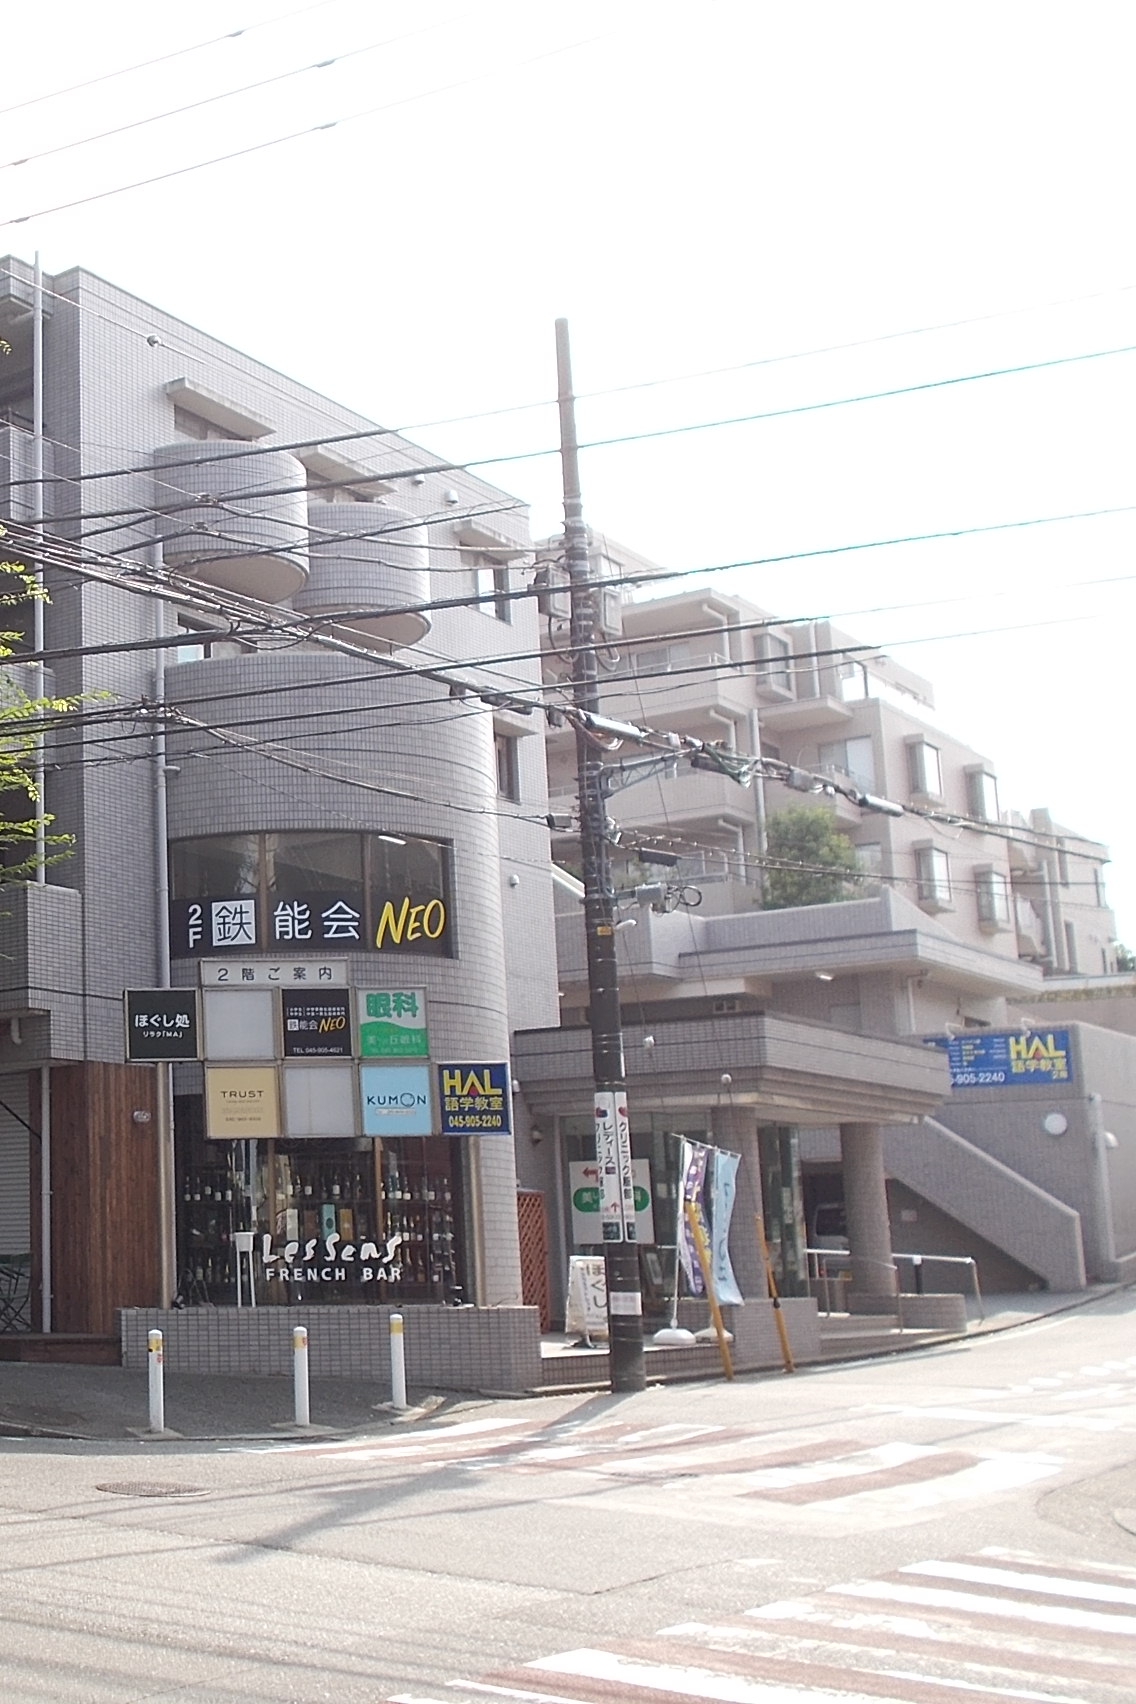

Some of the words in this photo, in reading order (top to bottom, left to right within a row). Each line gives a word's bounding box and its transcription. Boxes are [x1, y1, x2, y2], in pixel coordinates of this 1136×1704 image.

[376, 896, 446, 948] NEO
[217, 967, 333, 982] 2階ご案内
[366, 992, 419, 1018] 眼科
[135, 1014, 190, 1028] ほぐし処
[318, 1017, 346, 1033] NEO
[1009, 1034, 1066, 1059] HAL
[443, 1069, 503, 1096] HAL
[221, 1090, 264, 1098] TRUST
[367, 1093, 426, 1107] KUMON
[445, 1097, 503, 1111] 語学教室
[448, 1115, 501, 1128] 045-905-2240
[603, 1122, 616, 1166] レディース
[266, 1267, 346, 1281] FRENCH
[363, 1267, 401, 1281] BAR
